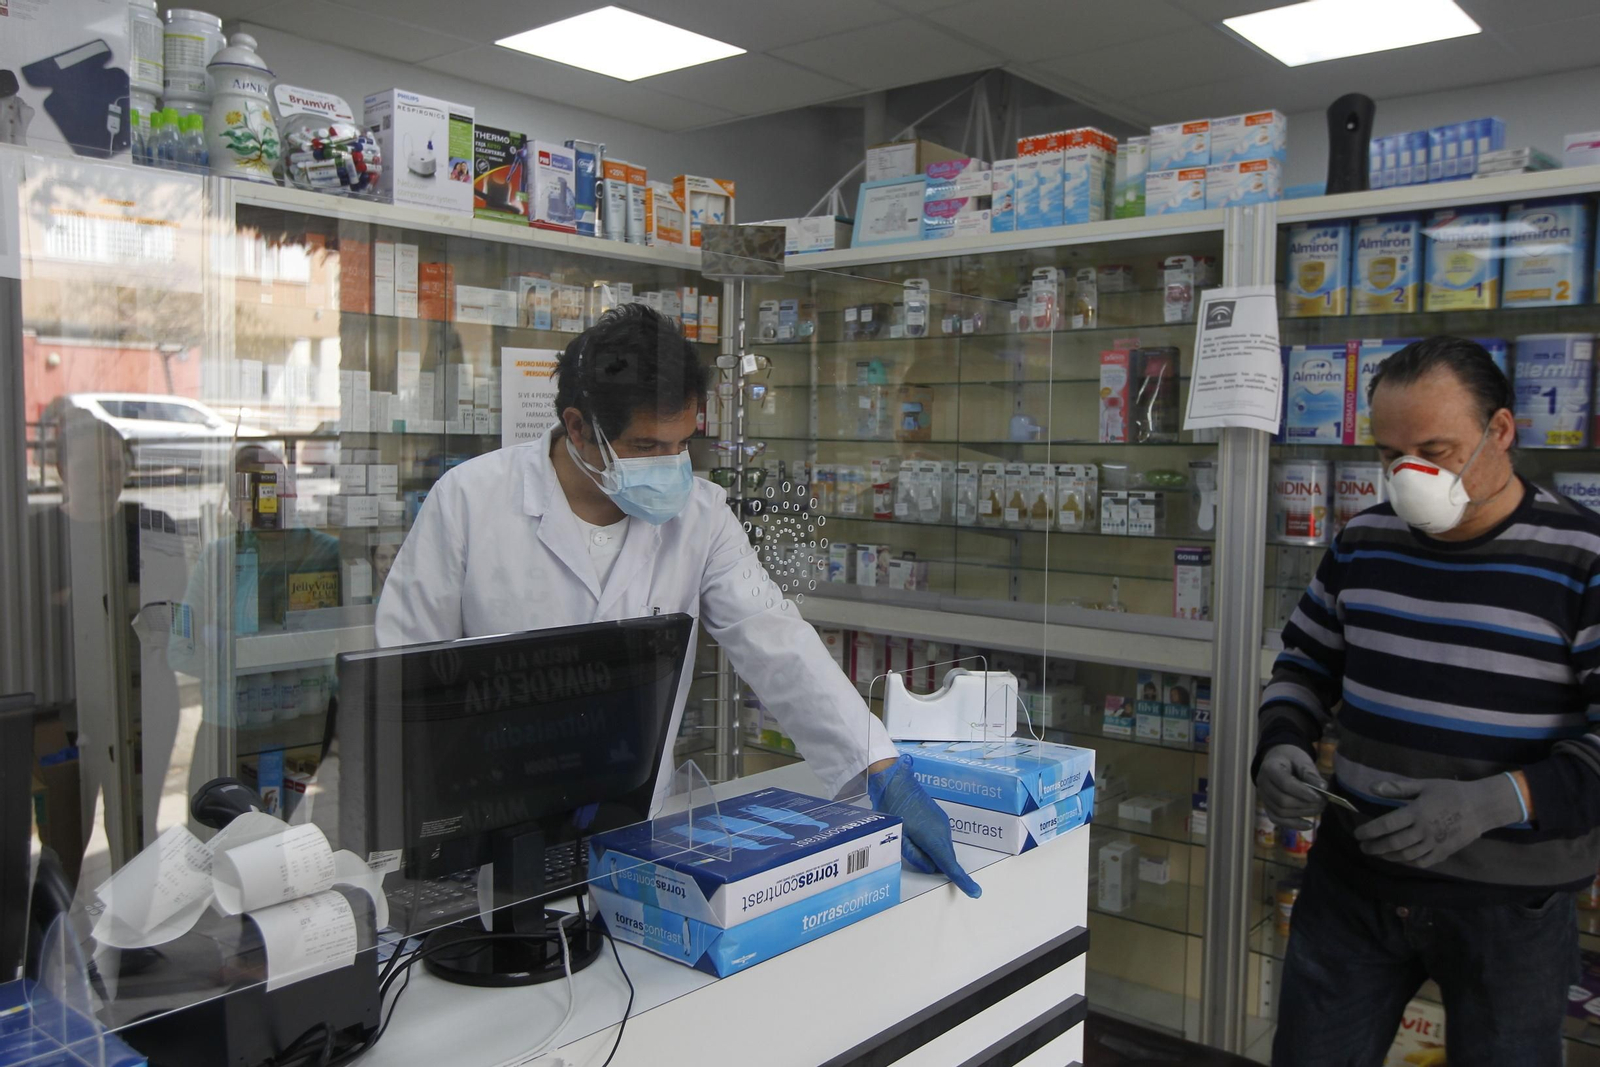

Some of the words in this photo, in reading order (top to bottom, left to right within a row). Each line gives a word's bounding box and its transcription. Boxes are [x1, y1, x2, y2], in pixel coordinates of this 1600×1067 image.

[289, 94, 337, 112] BrumVit
[397, 92, 419, 103] PHILIPS
[397, 105, 445, 120] RESPIRONICS
[474, 130, 510, 145] THERMO
[1289, 241, 1338, 254] Almirón
[1358, 236, 1411, 250] Almirón
[1323, 290, 1331, 305] 1
[1393, 287, 1405, 303] 2
[1473, 281, 1482, 298] 1
[1555, 279, 1570, 300] 2
[1292, 370, 1342, 383] Almirón
[1541, 386, 1557, 415] 1
[1345, 392, 1354, 433] FORMATO
[1334, 421, 1341, 438] 1
[1177, 553, 1199, 561] GOIBI
[1043, 771, 1081, 795] torrascontrast
[742, 863, 839, 912] torrascontrast
[802, 883, 891, 931] torrascontrast
[615, 911, 683, 946] torrascontrast
